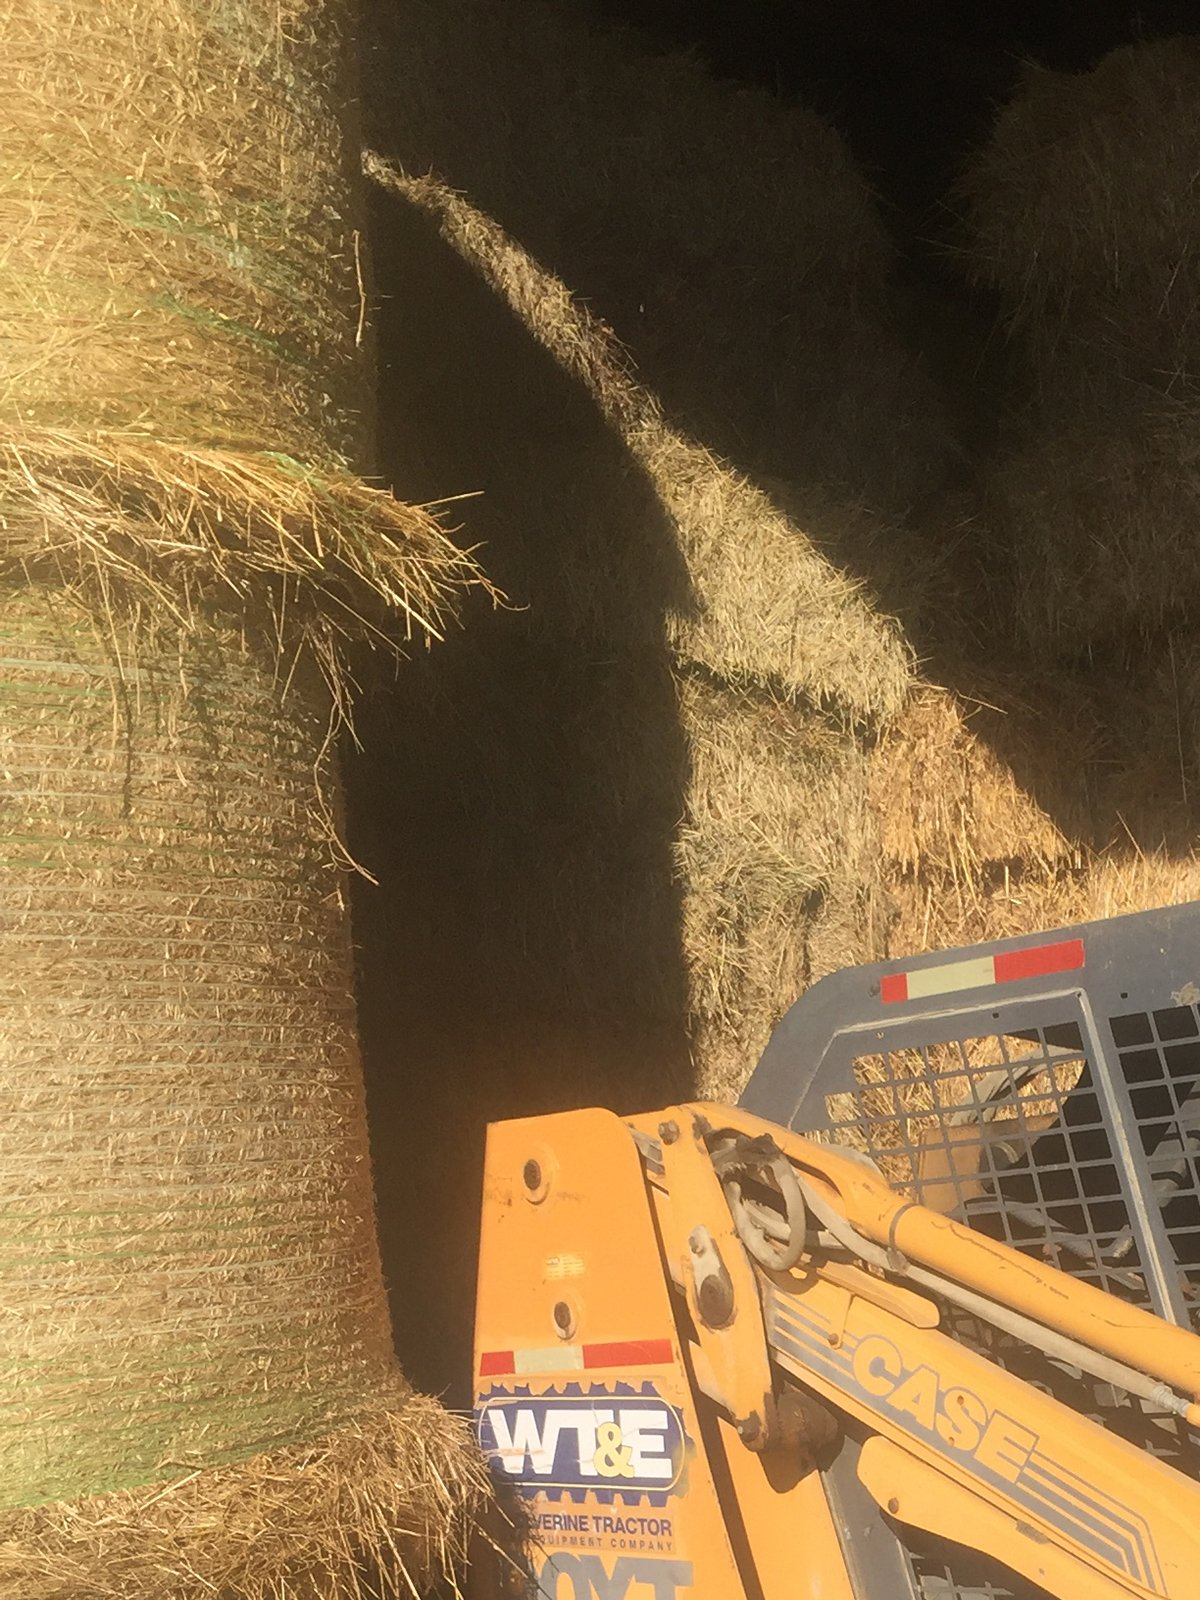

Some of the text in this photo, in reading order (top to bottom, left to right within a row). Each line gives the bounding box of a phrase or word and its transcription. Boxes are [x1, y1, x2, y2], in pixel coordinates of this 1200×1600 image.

[854, 1335, 1040, 1484] CASE
[488, 1409, 673, 1479] WT&E
[533, 1534, 673, 1551] QUIPMENT COMPANY
[537, 1513, 673, 1537] VERINE TRACTOR
